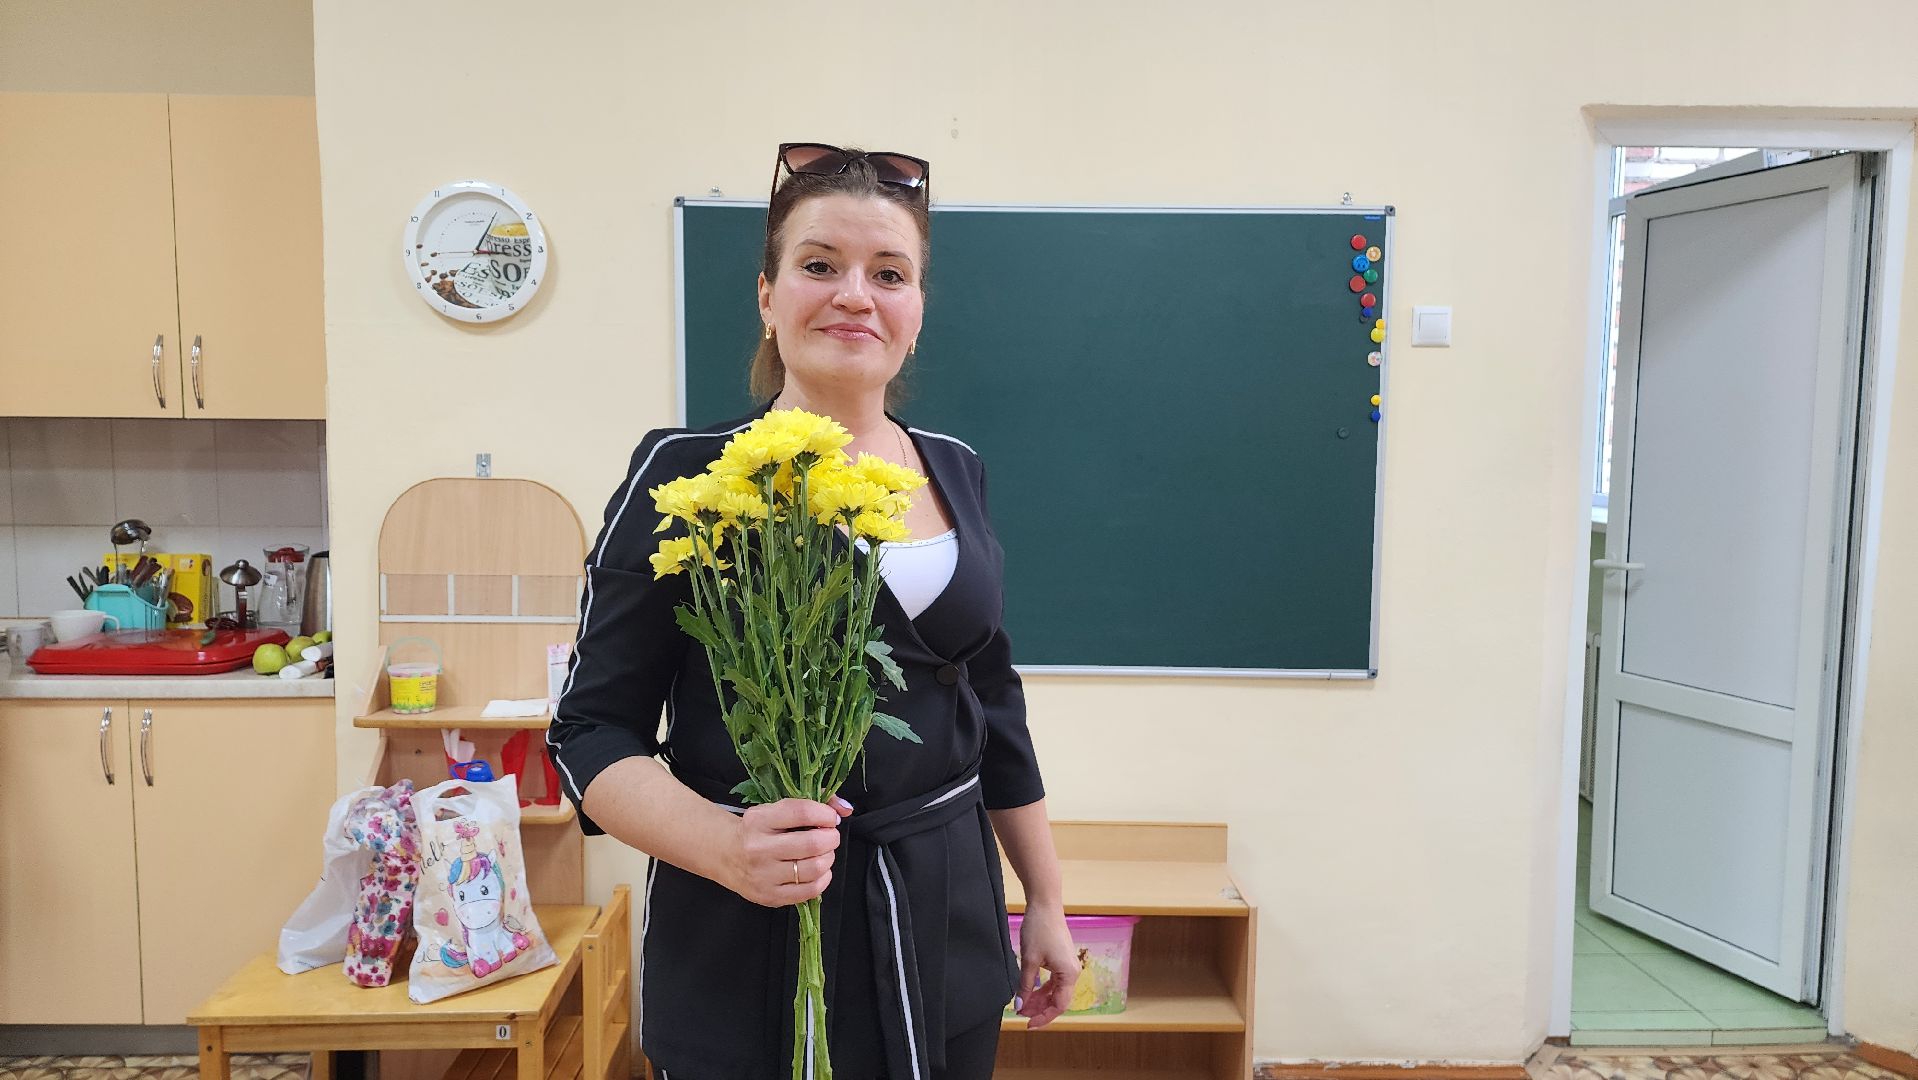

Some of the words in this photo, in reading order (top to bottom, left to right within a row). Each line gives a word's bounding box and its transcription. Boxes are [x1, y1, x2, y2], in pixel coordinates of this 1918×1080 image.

[526, 212, 533, 220] 2
[405, 249, 411, 257] 9
[537, 245, 544, 253] 3
[416, 282, 422, 290] 8
[508, 303, 515, 311] 5
[476, 313, 482, 321] 6
